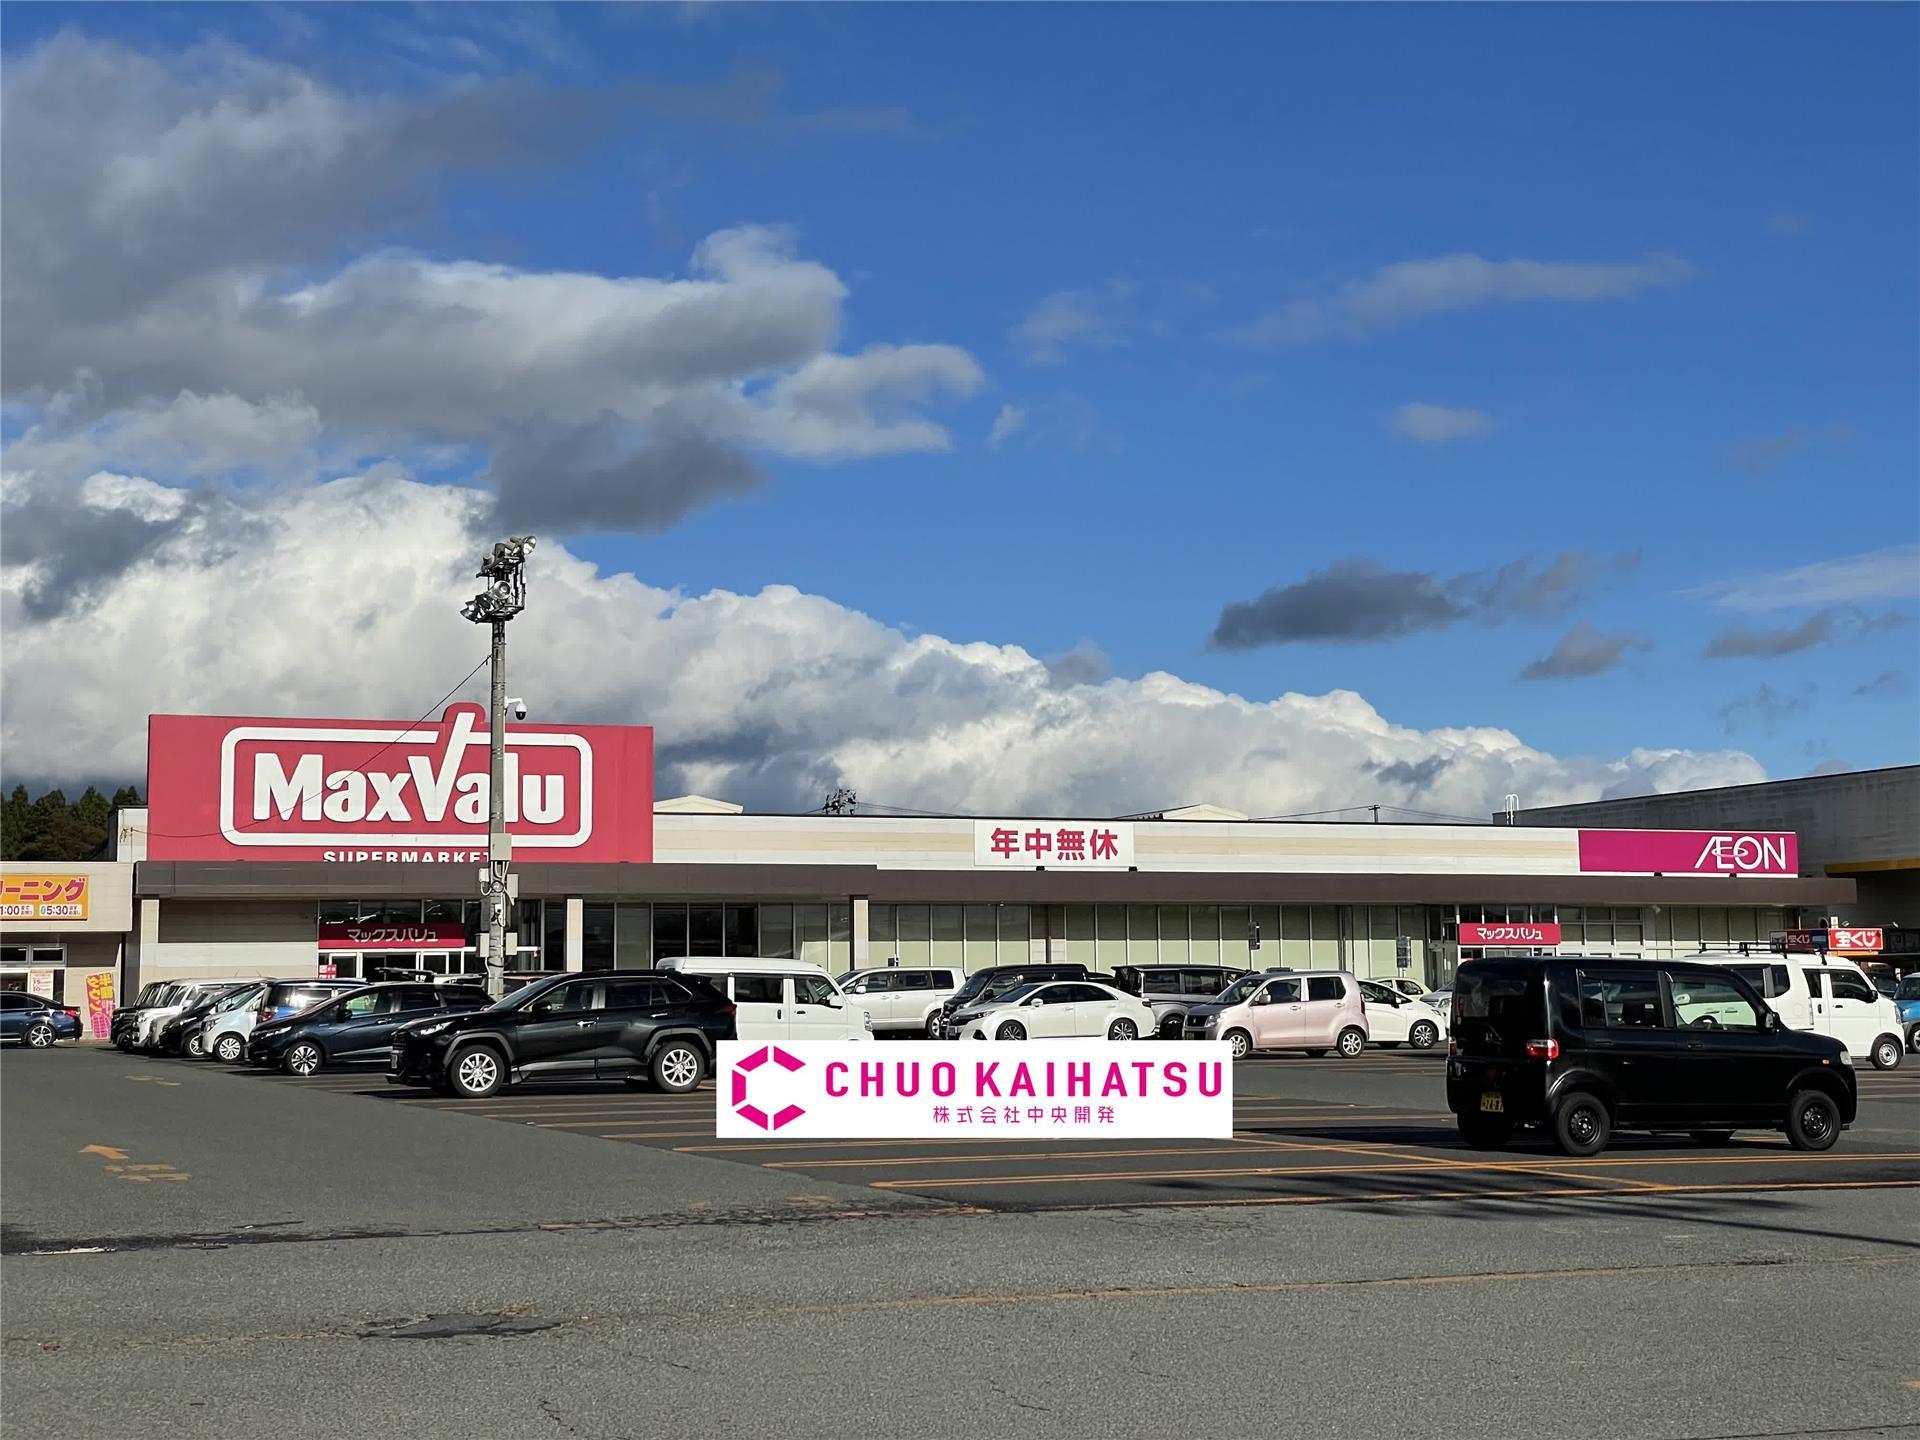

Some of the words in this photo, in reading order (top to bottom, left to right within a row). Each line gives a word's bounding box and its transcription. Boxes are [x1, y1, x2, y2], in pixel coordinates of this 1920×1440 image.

[253, 712, 565, 824] MaxValu
[990, 827, 1119, 860] 年中無休
[347, 928, 439, 942] マックスバリュ
[1477, 927, 1544, 940] マックスバリュ
[1835, 931, 1876, 947] 宝くじ
